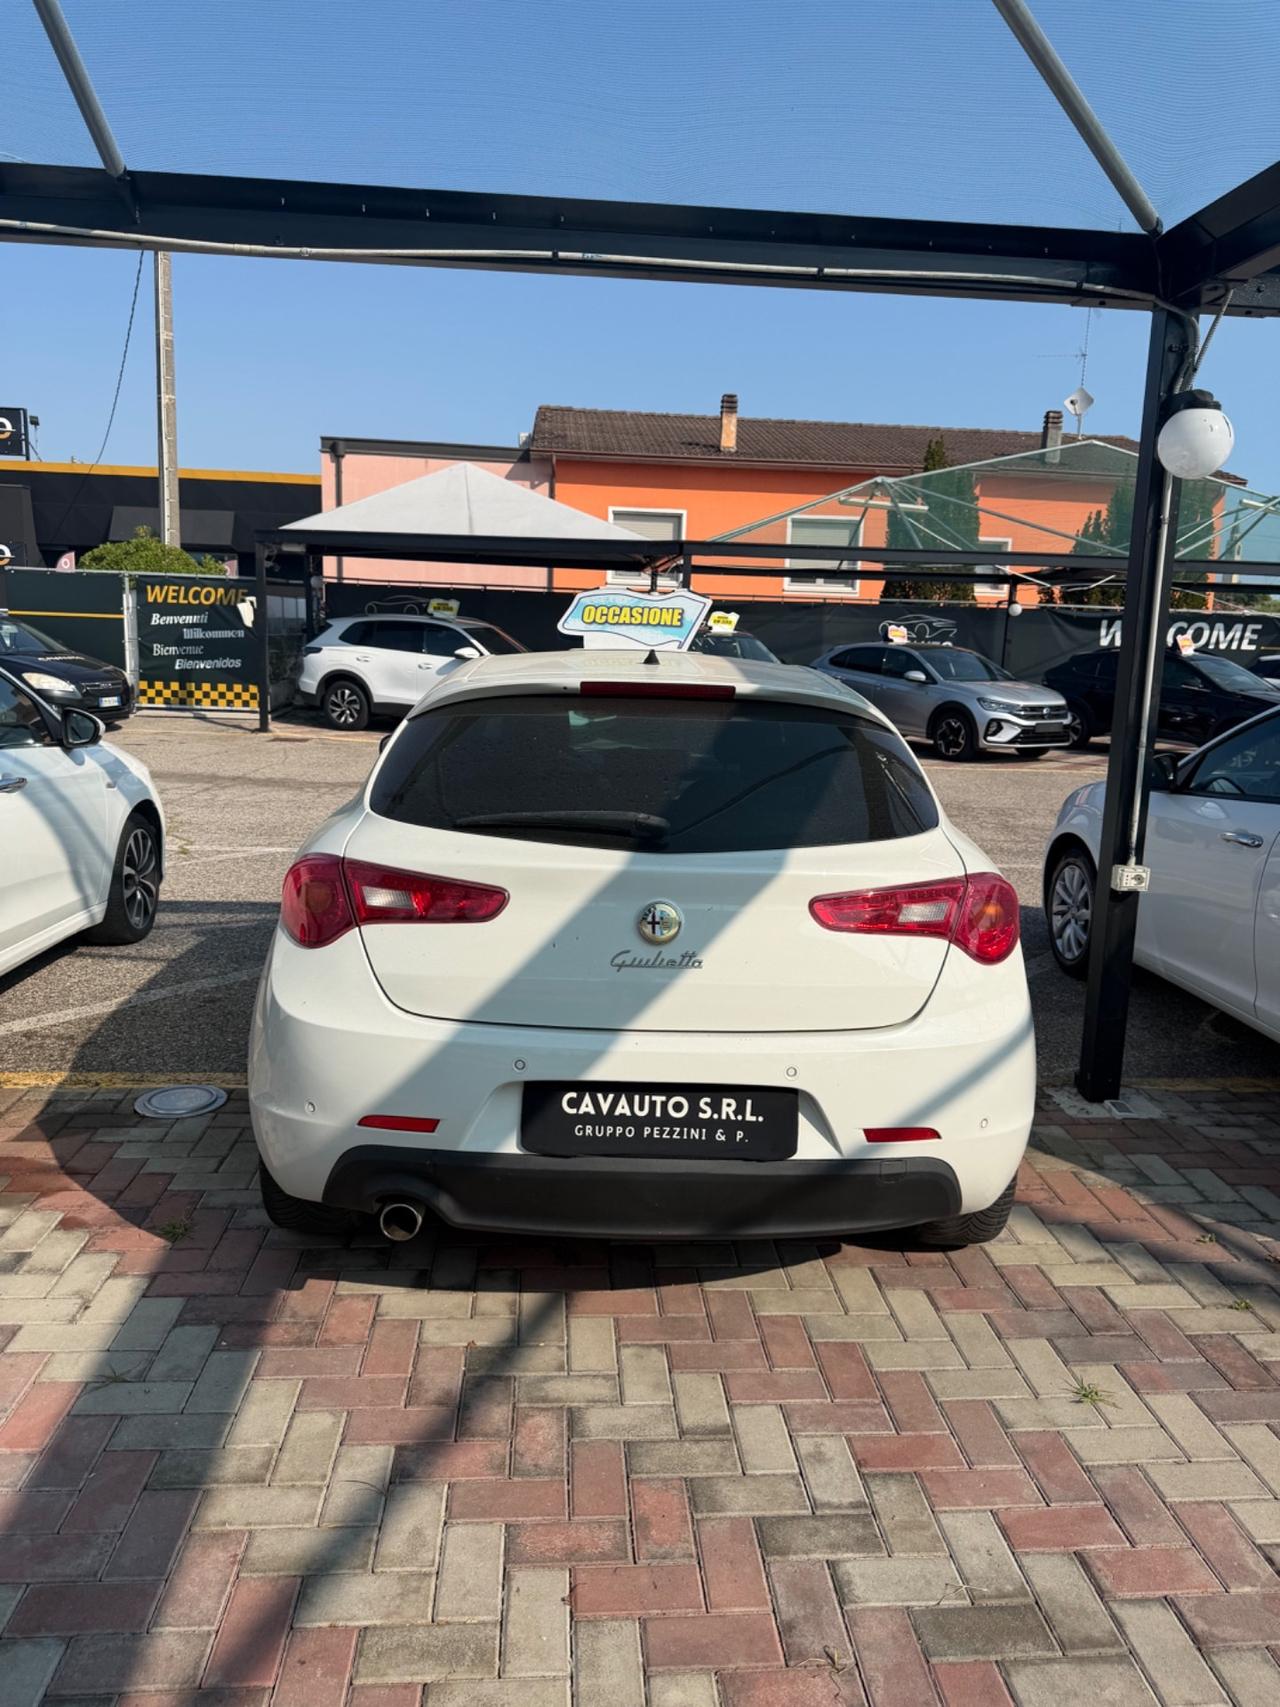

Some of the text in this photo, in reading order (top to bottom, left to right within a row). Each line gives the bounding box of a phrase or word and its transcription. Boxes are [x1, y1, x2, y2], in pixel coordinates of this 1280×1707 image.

[146, 585, 248, 606] WELCOME
[150, 611, 209, 626] Benvenuti
[582, 605, 684, 627] OCCASIONE
[1099, 619, 1263, 651] WCOME
[153, 643, 205, 656] Bienvenue
[174, 657, 243, 671] Bienvenidos
[609, 949, 704, 973] Giulietta
[561, 1091, 764, 1122] CAVAUTO S.R.L.
[574, 1124, 749, 1143] GRUPPO PEZZINI & P.
